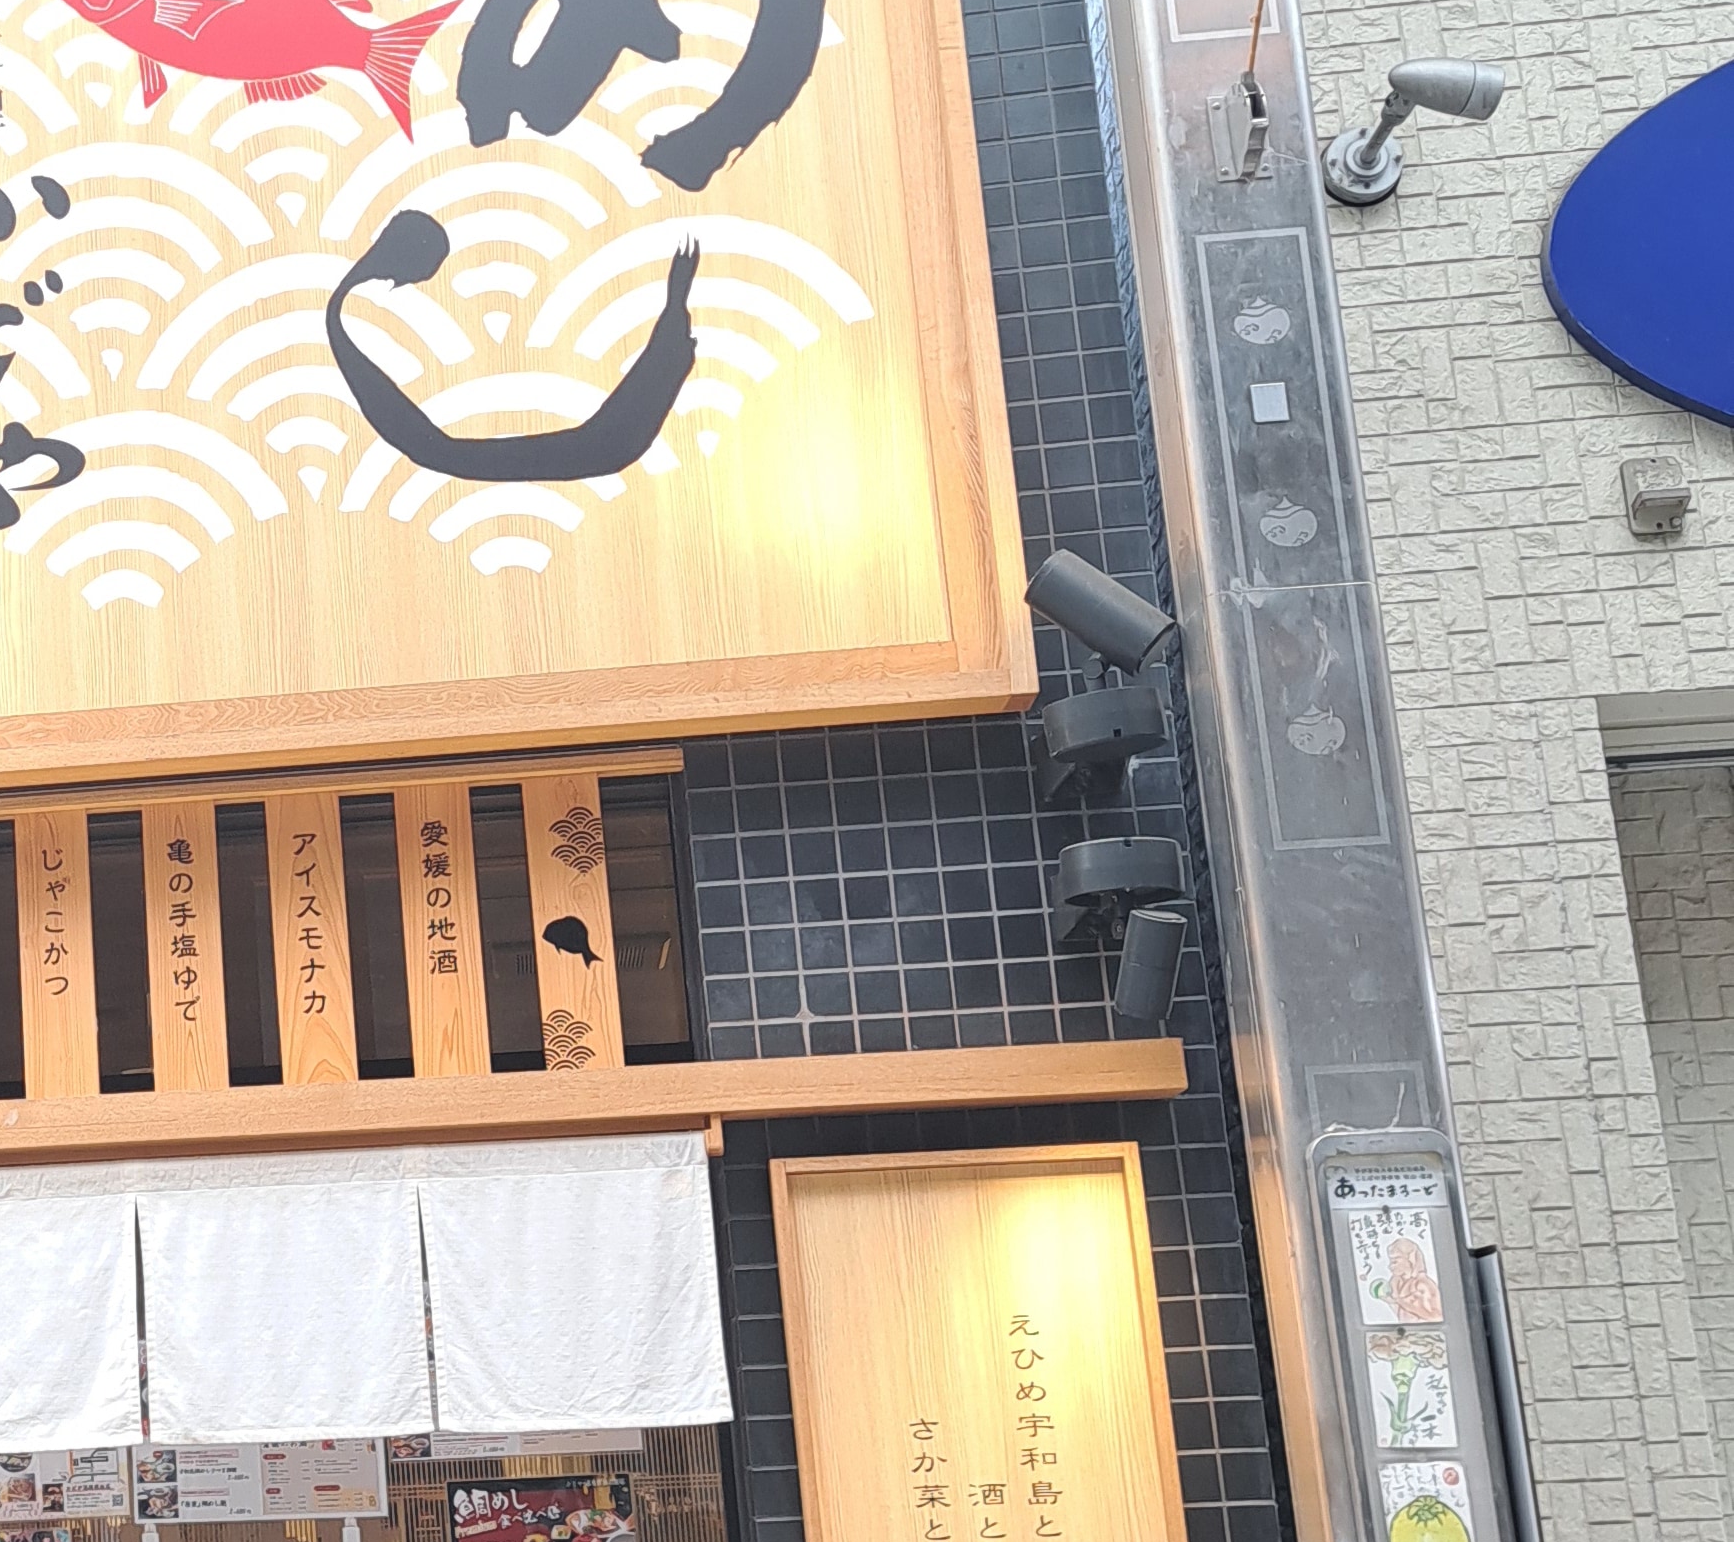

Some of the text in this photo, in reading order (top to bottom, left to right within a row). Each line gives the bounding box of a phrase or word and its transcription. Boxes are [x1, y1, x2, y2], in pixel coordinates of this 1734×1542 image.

[42, 848, 71, 997] じゃこかつ
[166, 837, 199, 1023] 亀の手塩ゆで
[291, 832, 328, 1015] アイスモナカ
[420, 819, 458, 976] 愛媛の地酒
[909, 1417, 952, 1542] さか菜と
[1008, 1314, 1064, 1538] えひめ宇和島と
[454, 1487, 529, 1524] 鯛めし
[968, 1483, 1008, 1540] 酒と
